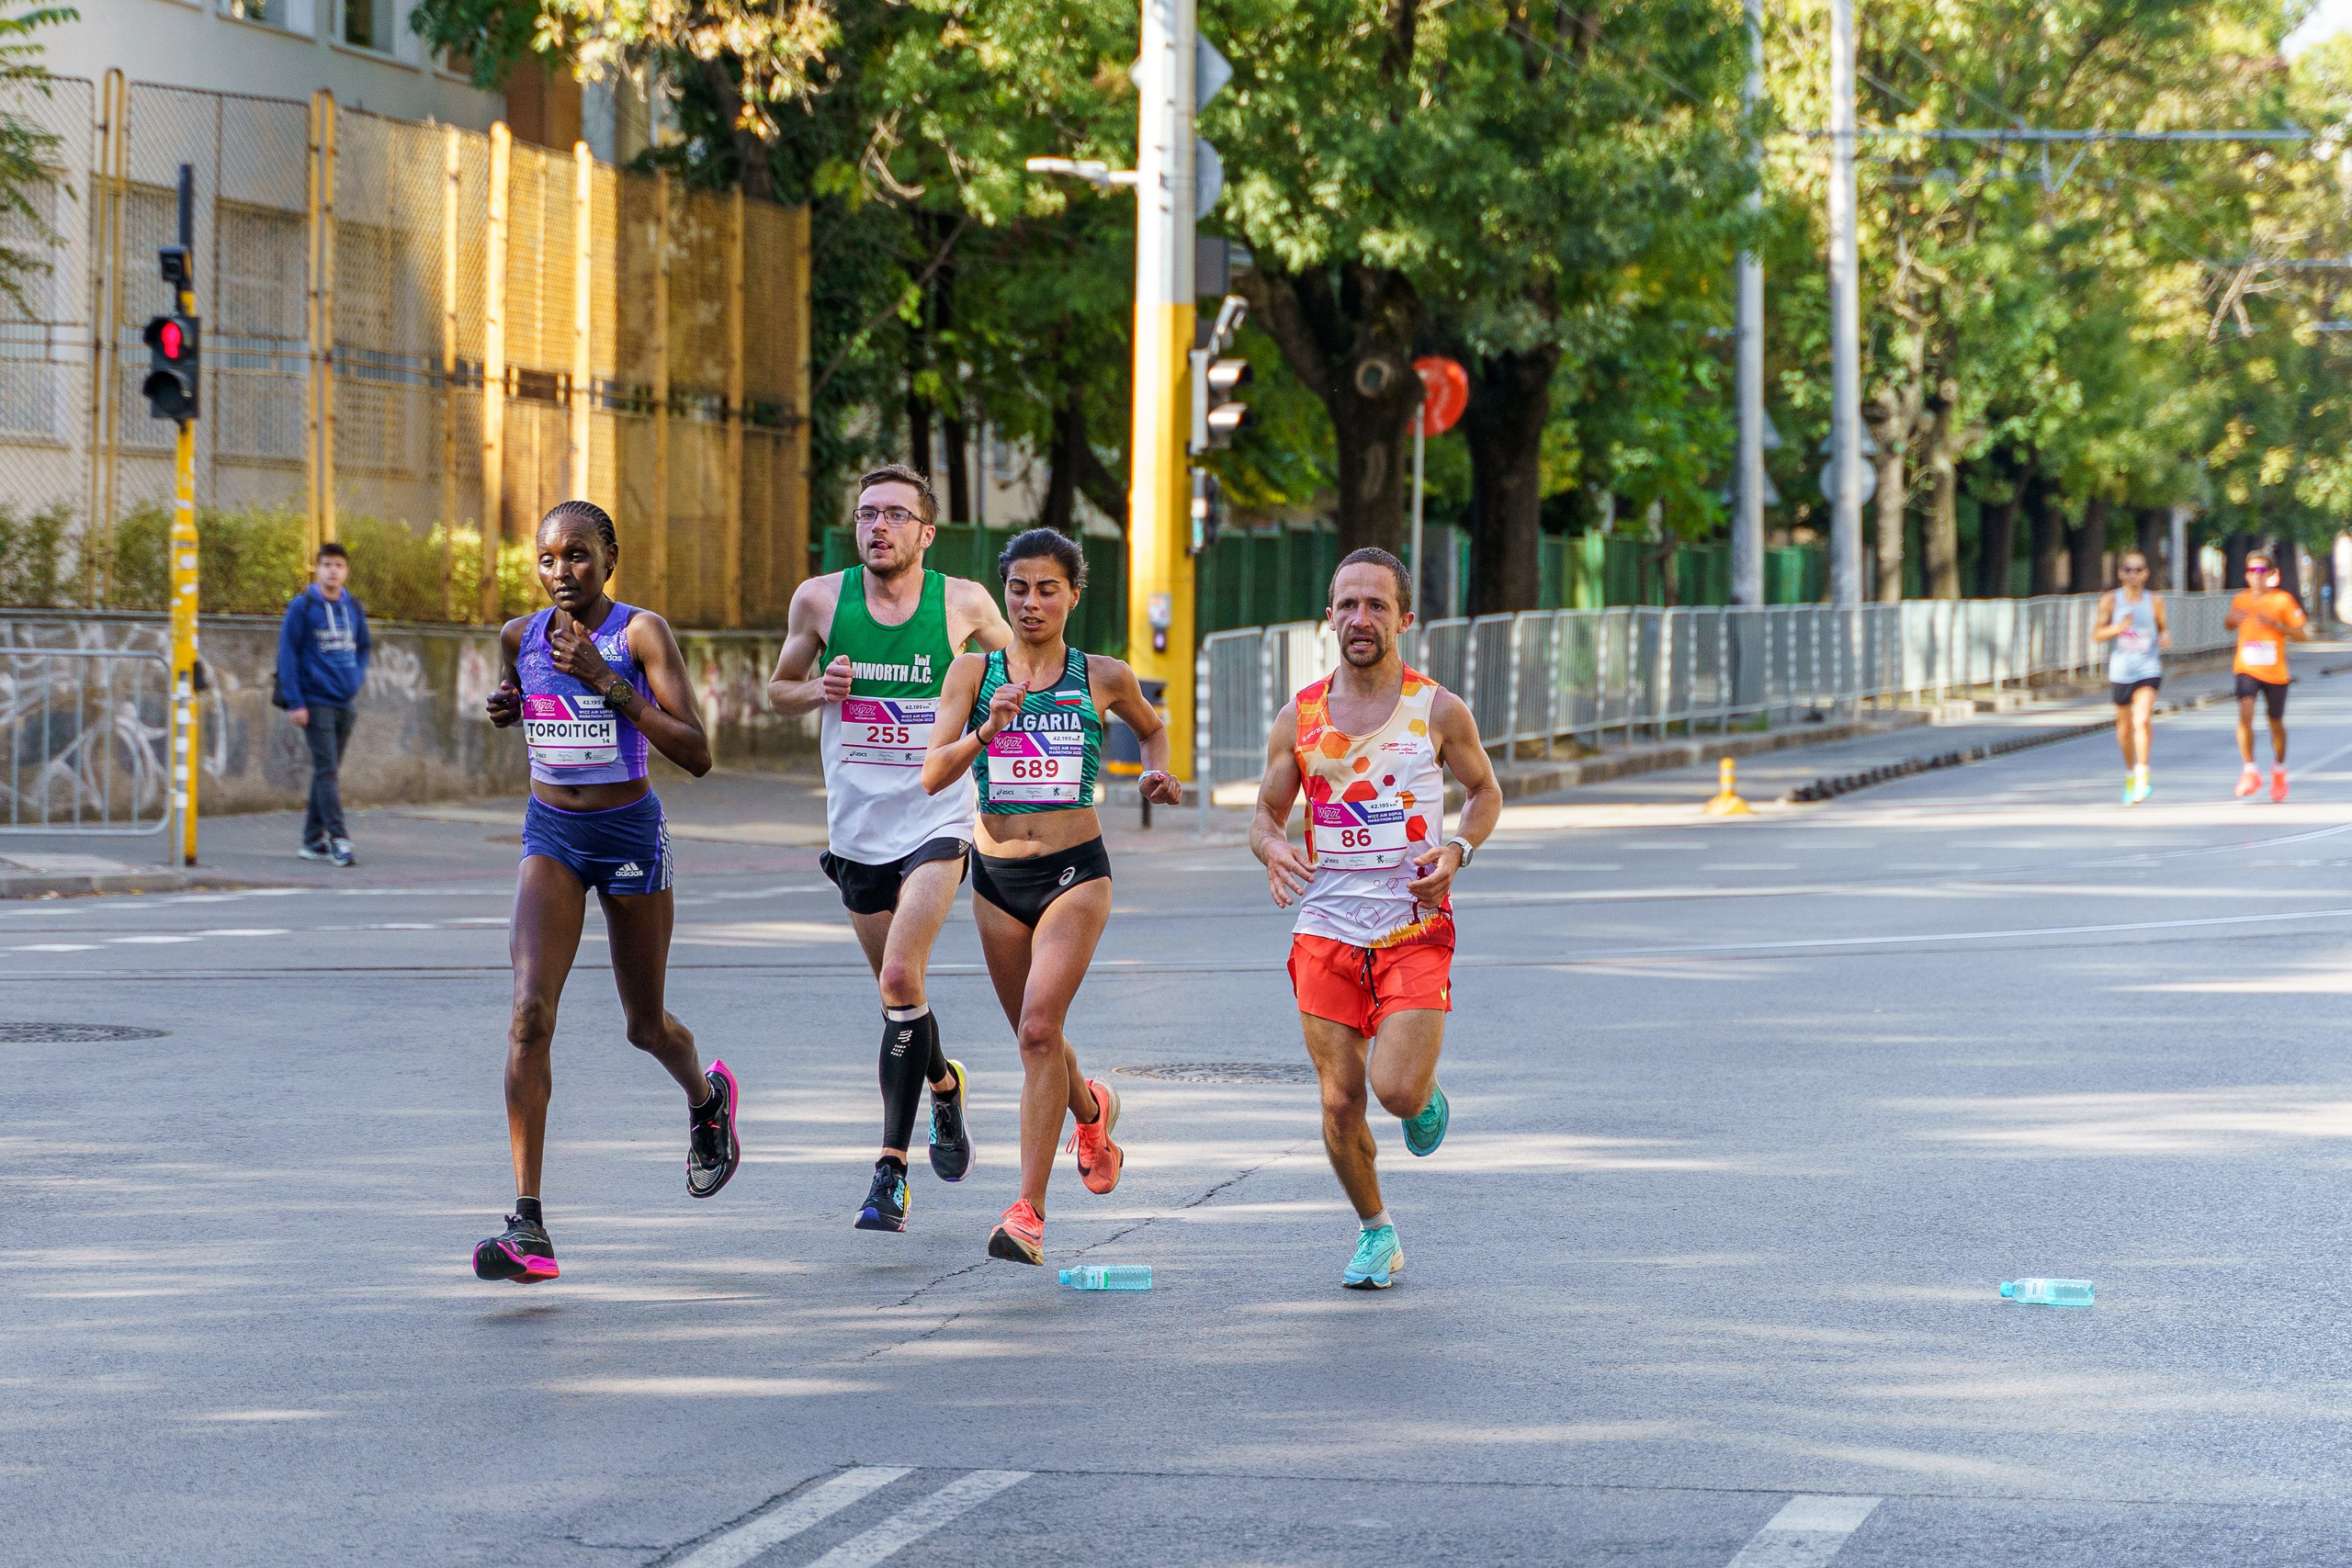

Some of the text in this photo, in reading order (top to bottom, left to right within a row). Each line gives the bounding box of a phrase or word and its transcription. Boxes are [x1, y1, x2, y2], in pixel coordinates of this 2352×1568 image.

[852, 661, 933, 684] MWORTH A.C.
[527, 722, 610, 738] TOROITICH
[1002, 713, 1082, 731] LGARIA
[866, 726, 910, 744] 255
[1012, 759, 1059, 779] 689
[1341, 828, 1372, 848] 86
